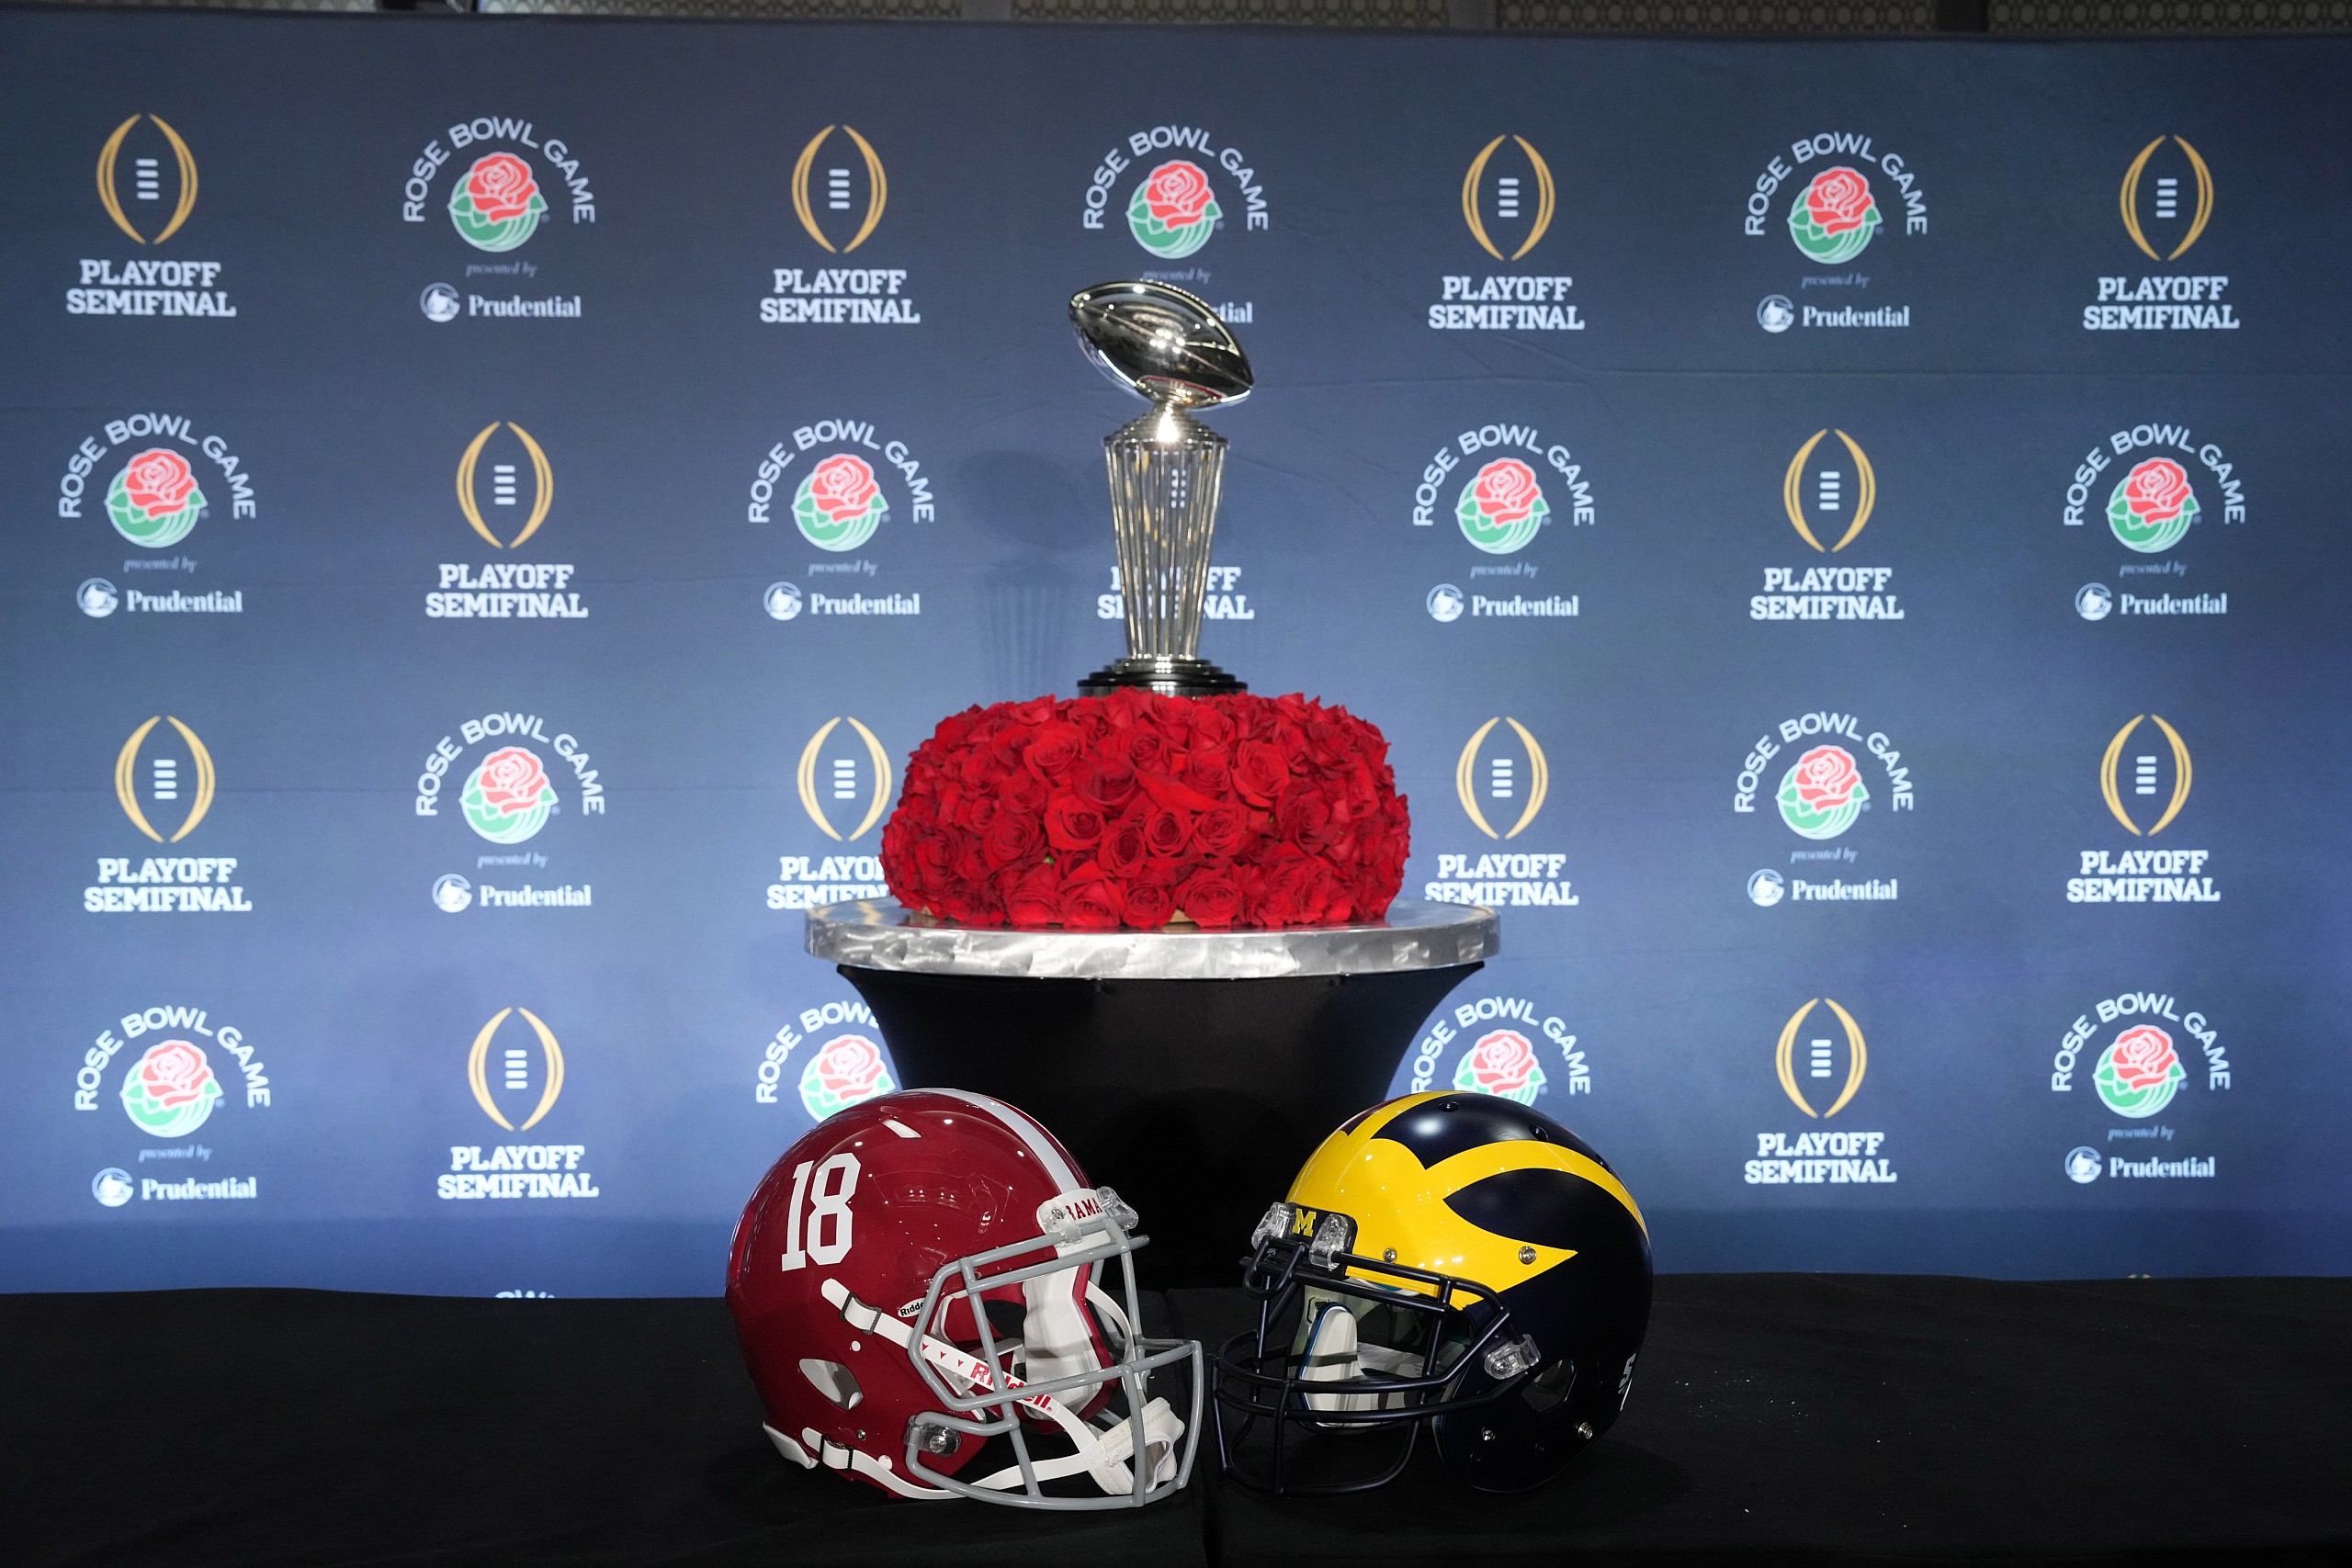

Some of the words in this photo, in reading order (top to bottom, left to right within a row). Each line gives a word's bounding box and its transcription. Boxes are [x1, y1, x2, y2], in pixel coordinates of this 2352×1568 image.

[402, 141, 450, 222] ROSE
[448, 116, 538, 149] BOWL
[543, 139, 595, 223] GAME
[1082, 148, 1130, 230] ROSE
[1128, 125, 1216, 157] BOWL
[1219, 148, 1269, 231] GAME
[1745, 155, 1792, 236] ROSE
[1792, 131, 1877, 164] BOWL
[1881, 152, 1928, 235] GAME
[79, 259, 221, 288] PLAYOFF
[773, 268, 907, 295] PLAYOFF
[1442, 276, 1573, 301] PLAYOFF
[2097, 276, 2229, 302] PLAYOFF
[66, 288, 237, 318] SEMIFINAL
[469, 294, 582, 318] Prudential
[759, 297, 921, 324] SEMIFINAL
[1803, 305, 1910, 328] Prudential
[1428, 304, 1586, 331] SEMIFINAL
[2083, 304, 2240, 331] SEMIFINAL
[58, 436, 107, 518] ROSE
[105, 412, 198, 446] BOWL
[202, 435, 256, 520] GAME
[748, 443, 795, 524] ROSE
[793, 419, 881, 451] BOWL
[885, 440, 935, 524] GAME
[1412, 446, 1459, 526] ROSE
[1457, 423, 1544, 456] BOWL
[1547, 445, 1595, 526] GAME
[2063, 446, 2111, 526] ROSE
[2109, 423, 2195, 456] BOWL
[2199, 444, 2245, 525] GAME
[438, 563, 574, 590] PLAYOFF
[1763, 567, 1893, 592] PLAYOFF
[126, 589, 243, 613] Prudential
[425, 592, 589, 618] SEMIFINAL
[810, 592, 921, 615] Prudential
[1472, 594, 1579, 616] Prudential
[1749, 594, 1905, 621] SEMIFINAL
[2120, 592, 2228, 615] Prudential
[415, 736, 463, 817] ROSE
[460, 711, 550, 745] BOWL
[553, 733, 605, 816] GAME
[1734, 735, 1781, 813] ROSE
[1779, 711, 1863, 743] BOWL
[1867, 732, 1914, 812] GAME
[97, 857, 238, 884] PLAYOFF
[779, 855, 886, 882] PLAYO
[1437, 853, 1566, 879] PLAYOFF
[2079, 850, 2209, 875] PLAYOFF
[84, 886, 253, 913] SEMIFINAL
[480, 884, 592, 908] Prudential
[1424, 881, 1579, 907] SEMIFINAL
[1792, 878, 1898, 901] Prudential
[2066, 877, 2221, 903] SEMIFINAL
[1410, 1019, 1457, 1095] ROSE
[1454, 996, 1540, 1028] BOWL
[1543, 1016, 1591, 1095] GAME
[2051, 1014, 2098, 1091] ROSE
[2095, 991, 2179, 1023] BOWL
[2183, 1011, 2231, 1090] GAME
[74, 1030, 124, 1111] ROSE
[120, 1005, 214, 1039] BOWL
[217, 1026, 271, 1109] GAME
[755, 1023, 803, 1104] ROSE
[450, 1145, 585, 1171] PLAYOFF
[1757, 1132, 1885, 1157] PLAYOFF
[1744, 1158, 1897, 1184] SEMIFINAL
[2109, 1156, 2215, 1179] Prudential
[141, 1176, 257, 1201] Prudential
[437, 1172, 600, 1200] SEMIFINAL
[781, 1152, 862, 1272] 18
[1292, 1208, 1317, 1237] M
